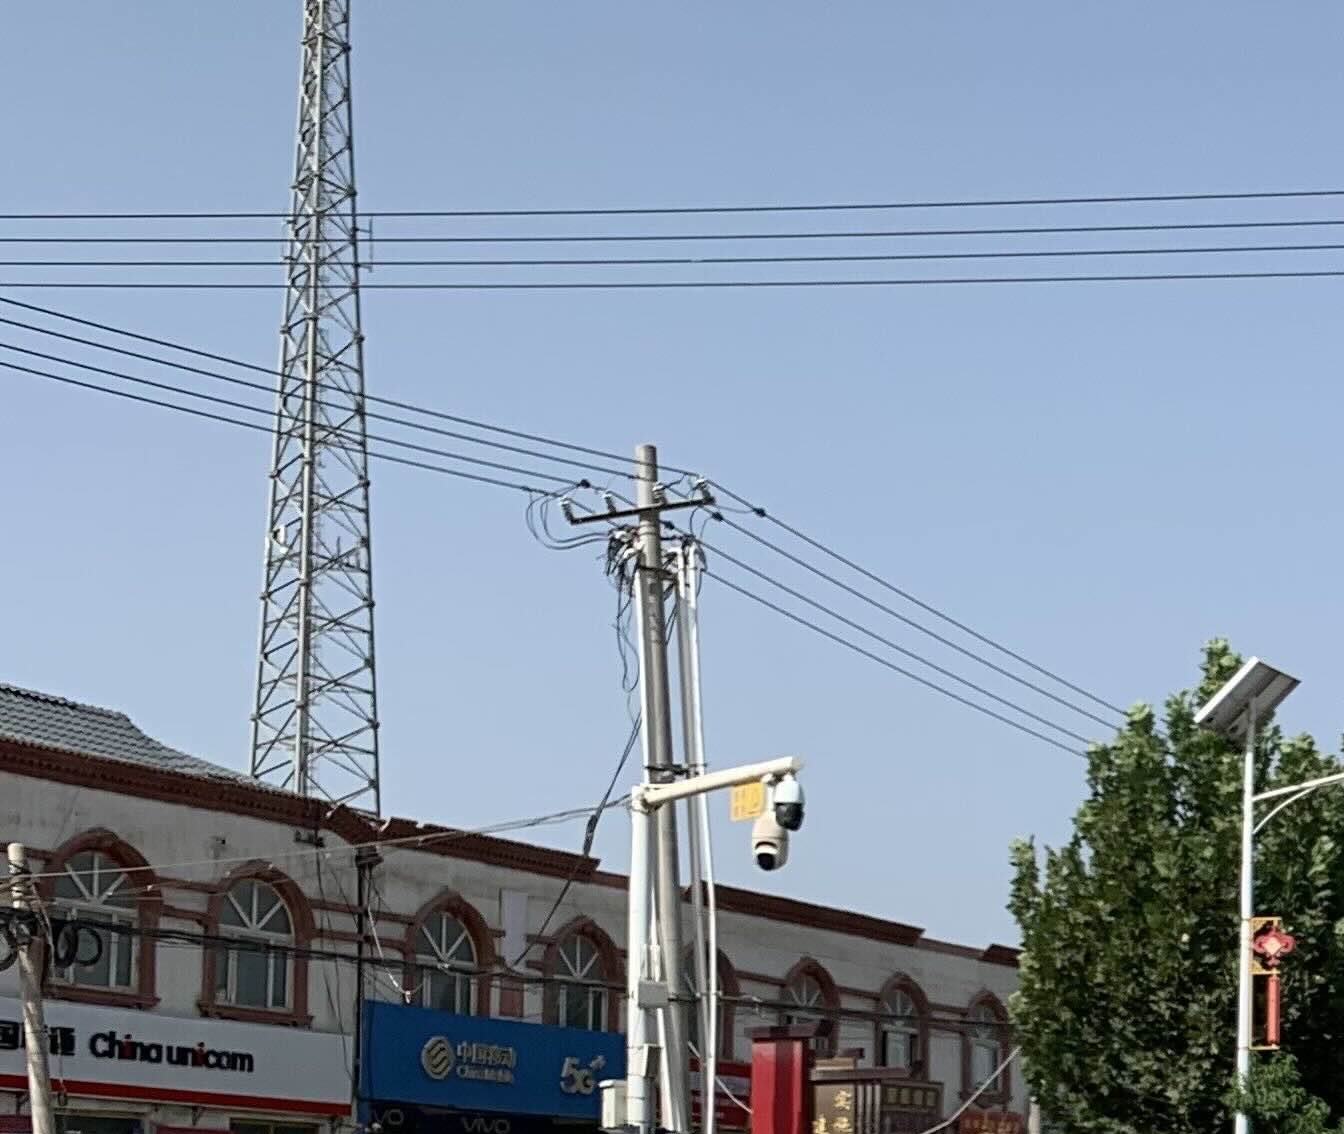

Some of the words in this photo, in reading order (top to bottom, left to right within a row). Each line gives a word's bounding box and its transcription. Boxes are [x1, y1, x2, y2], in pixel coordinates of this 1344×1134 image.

[0, 1020, 76, 1057] 国通
[90, 1031, 163, 1064] China
[166, 1041, 254, 1073] unicom
